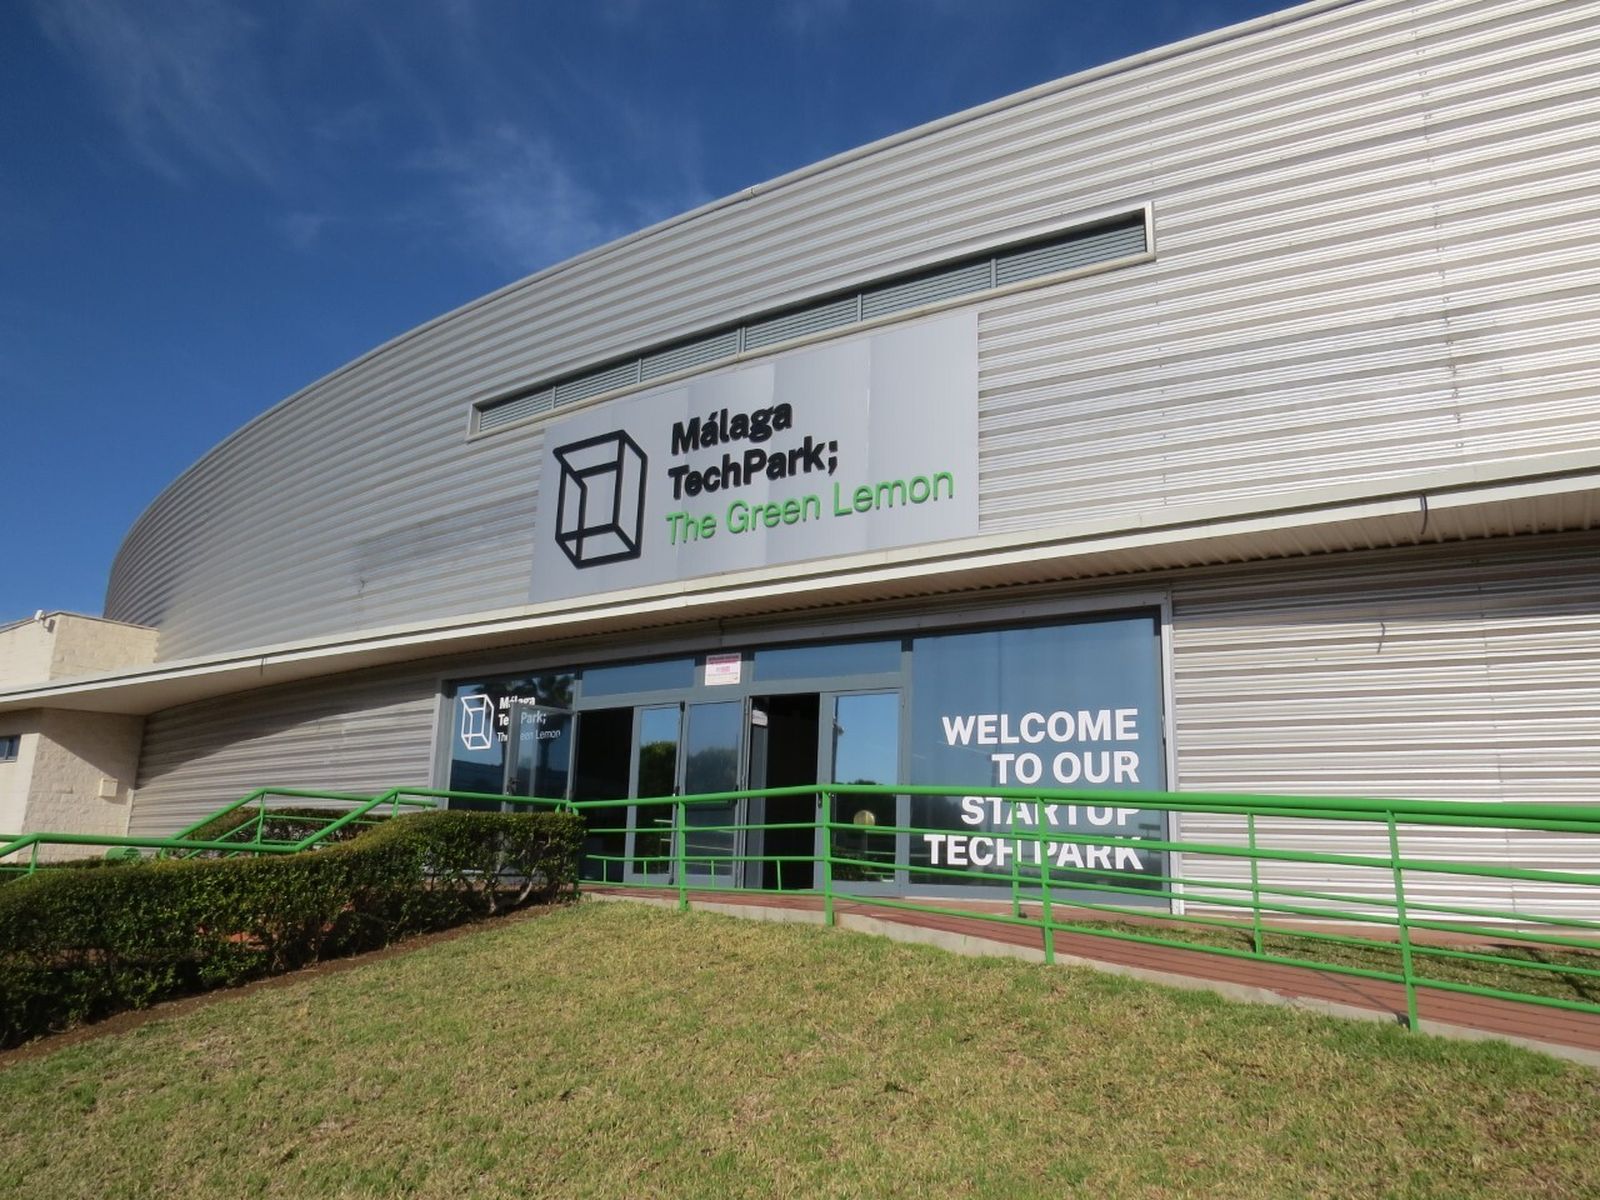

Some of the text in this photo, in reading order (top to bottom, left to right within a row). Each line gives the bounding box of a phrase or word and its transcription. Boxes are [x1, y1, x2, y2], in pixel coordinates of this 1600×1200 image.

[671, 402, 793, 455] Málaga
[668, 436, 838, 500] TechPark;
[665, 471, 954, 545] The Green Lemon
[535, 729, 561, 740] Lemon
[942, 708, 1139, 745] WELCOME
[991, 751, 1140, 784] TO OUR
[961, 796, 1141, 826] STARTUP
[923, 834, 1144, 870] TECH PARK
